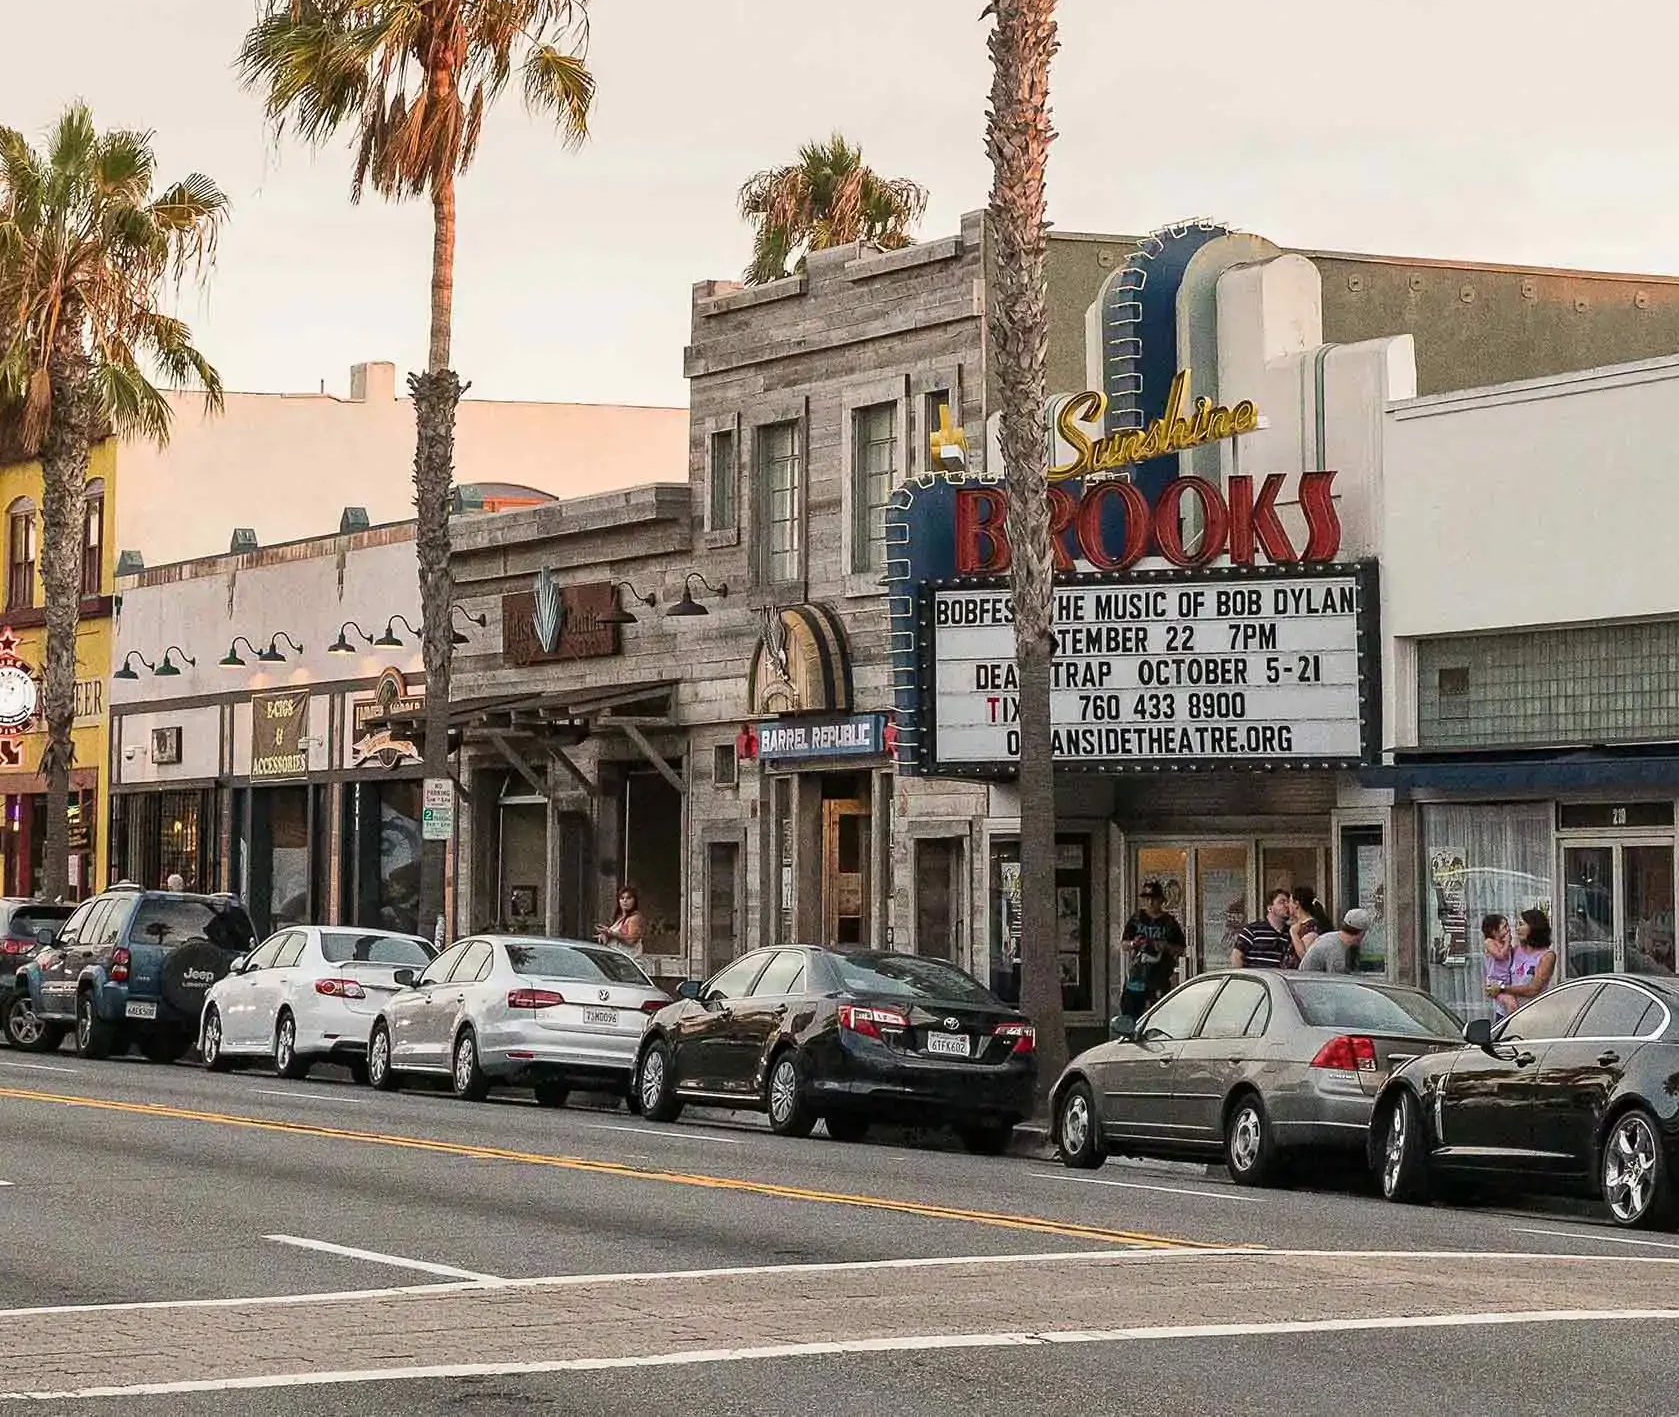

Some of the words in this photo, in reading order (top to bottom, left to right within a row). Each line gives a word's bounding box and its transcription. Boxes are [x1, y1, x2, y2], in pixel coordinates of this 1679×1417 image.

[1047, 368, 1260, 483] Sunshine
[936, 597, 1016, 625] BOBFES
[1053, 594, 1085, 621] HE
[1095, 591, 1167, 621] MUSIC
[1178, 591, 1206, 618] OF
[1216, 589, 1262, 616] BOB
[1273, 587, 1354, 615] DYLAN
[1056, 626, 1149, 655] TEMBER
[1166, 625, 1195, 652] 22
[1228, 623, 1277, 650] 7PM
[975, 661, 1111, 690] DEATRAP
[1138, 658, 1248, 686] OCTOBER
[73, 680, 103, 718] EER
[1079, 694, 1120, 721] 760
[1133, 693, 1175, 720] 433
[1188, 692, 1246, 719] 8900
[761, 728, 809, 752] BARREL
[811, 723, 870, 750] REPUBLIC
[1006, 725, 1292, 756] OANSIDETHEATRE.ORG
[252, 754, 306, 775] ACCESSORIES
[183, 967, 215, 982] Jeep
